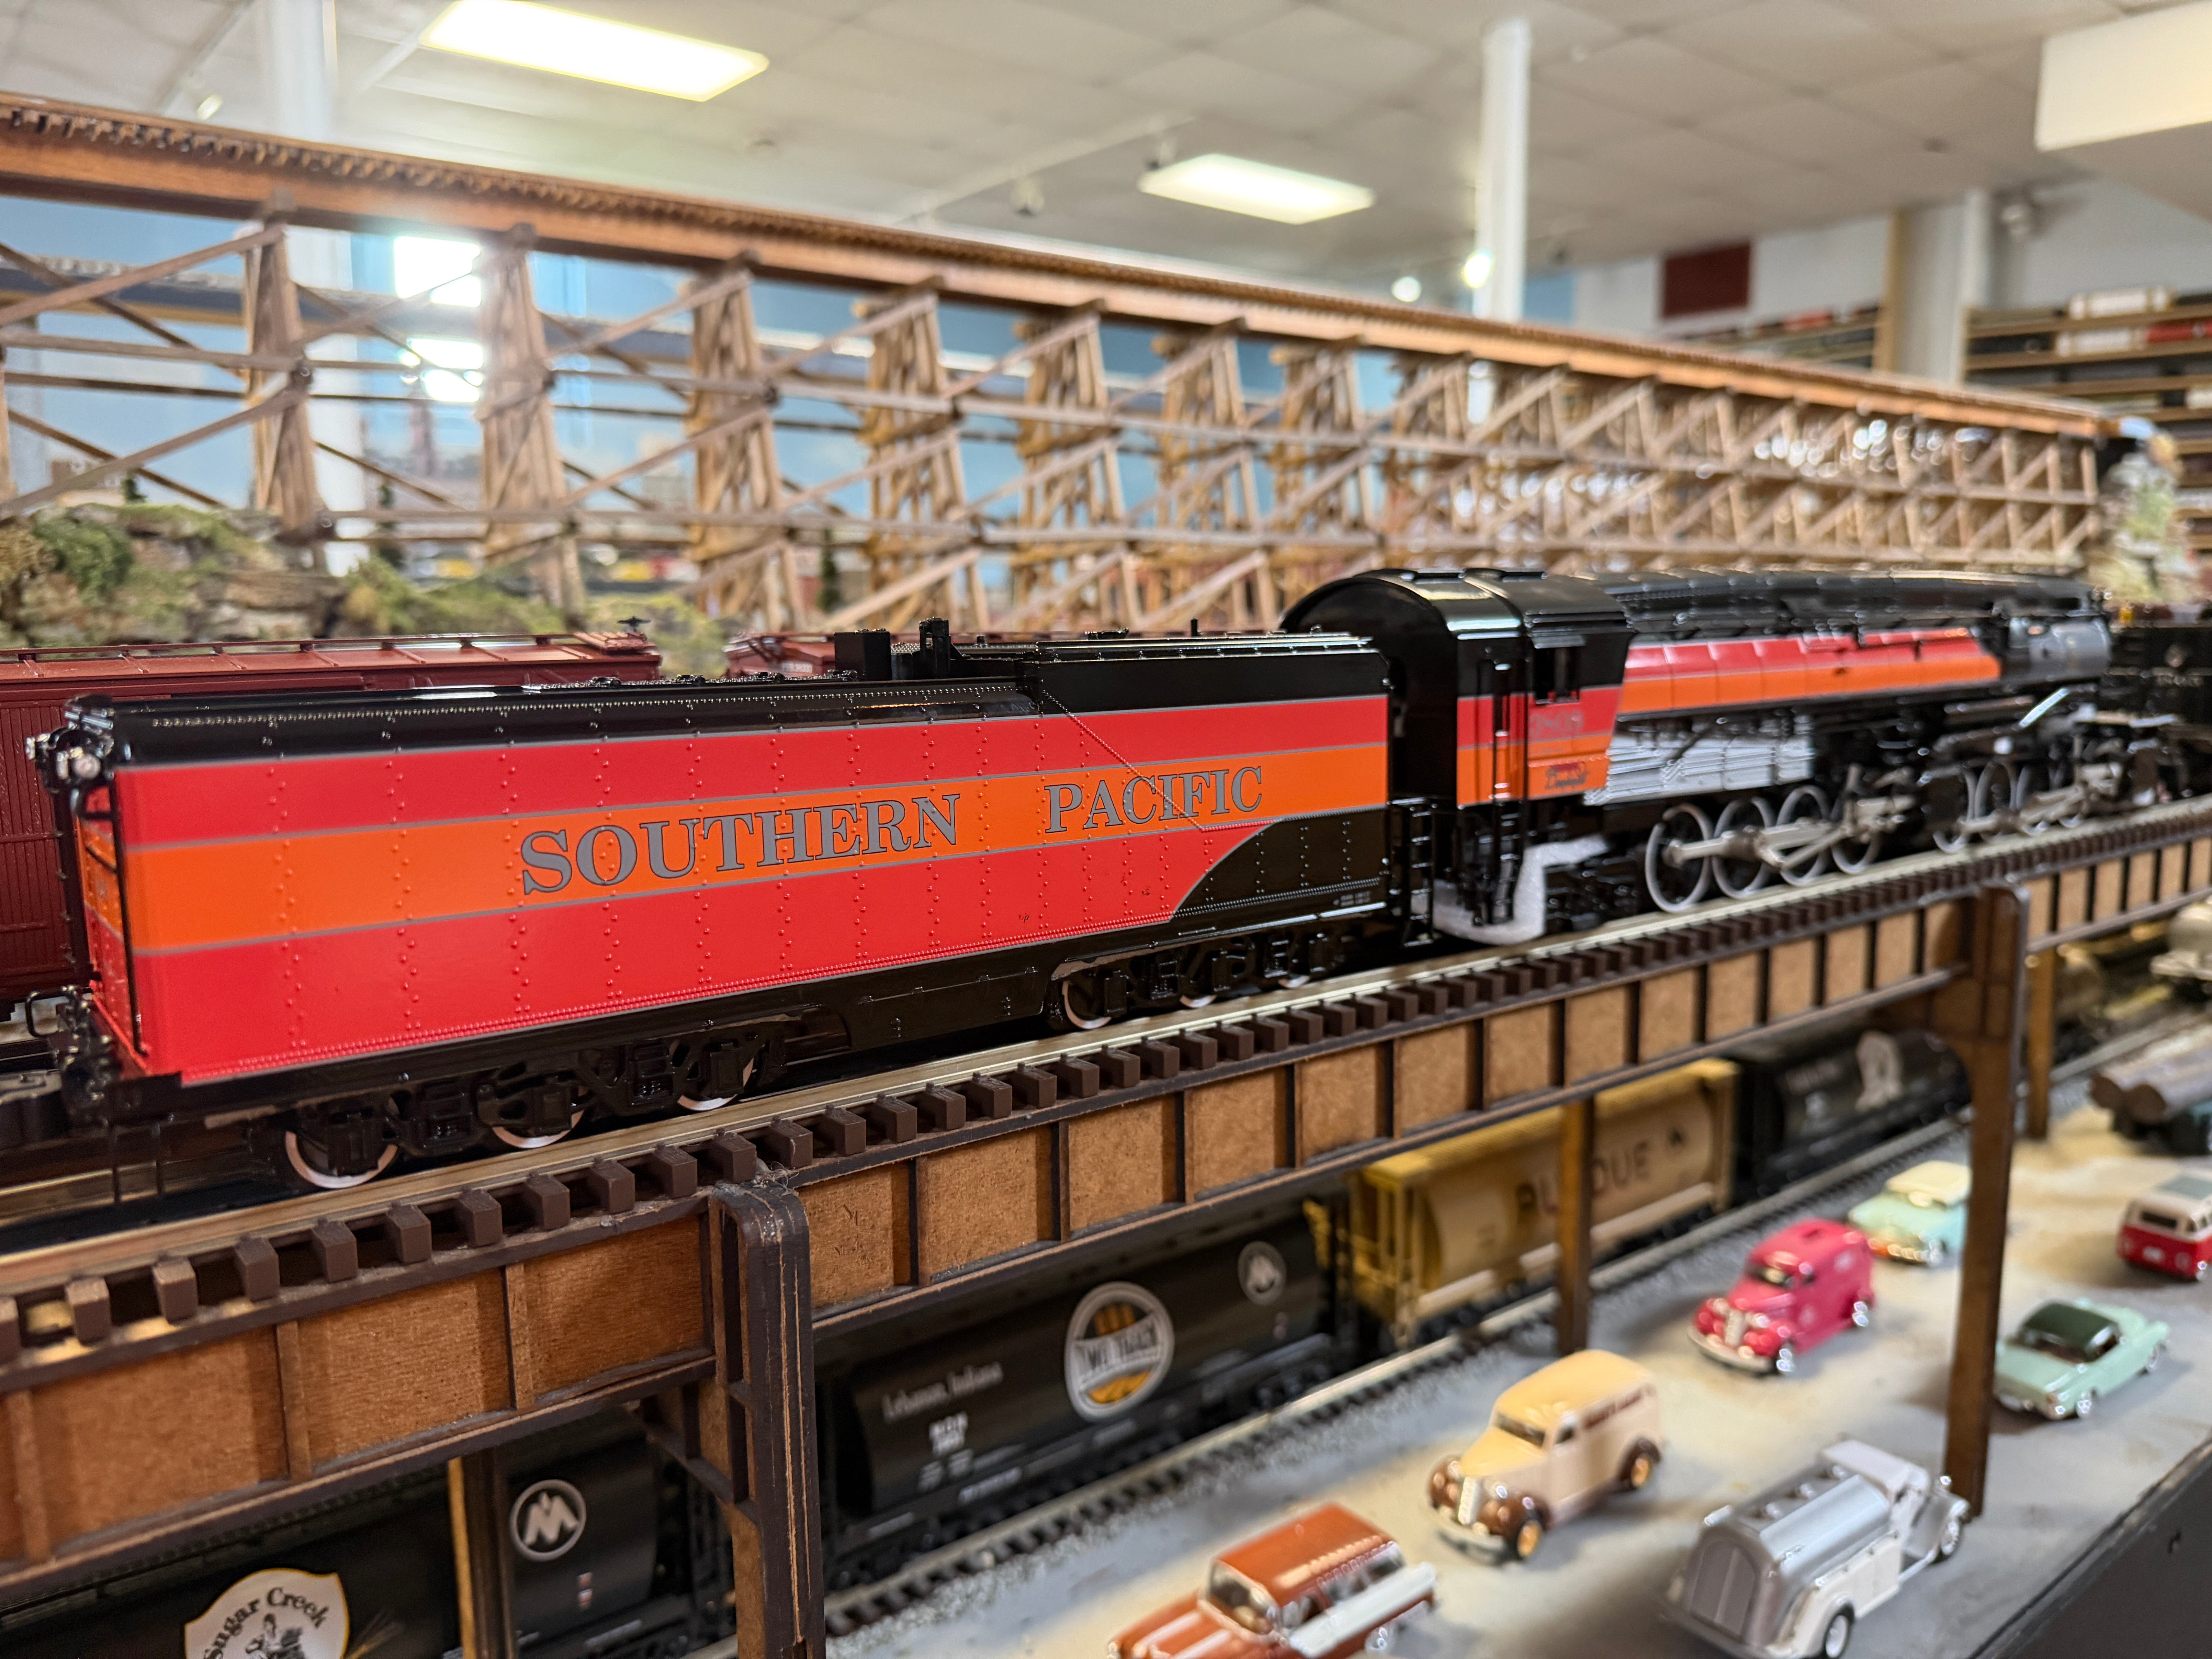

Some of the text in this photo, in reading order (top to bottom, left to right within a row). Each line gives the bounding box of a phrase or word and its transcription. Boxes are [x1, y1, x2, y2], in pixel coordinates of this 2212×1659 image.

[520, 766, 1262, 895] SOUTHERN PACIFIC
[266, 1587, 329, 1628] Creek
